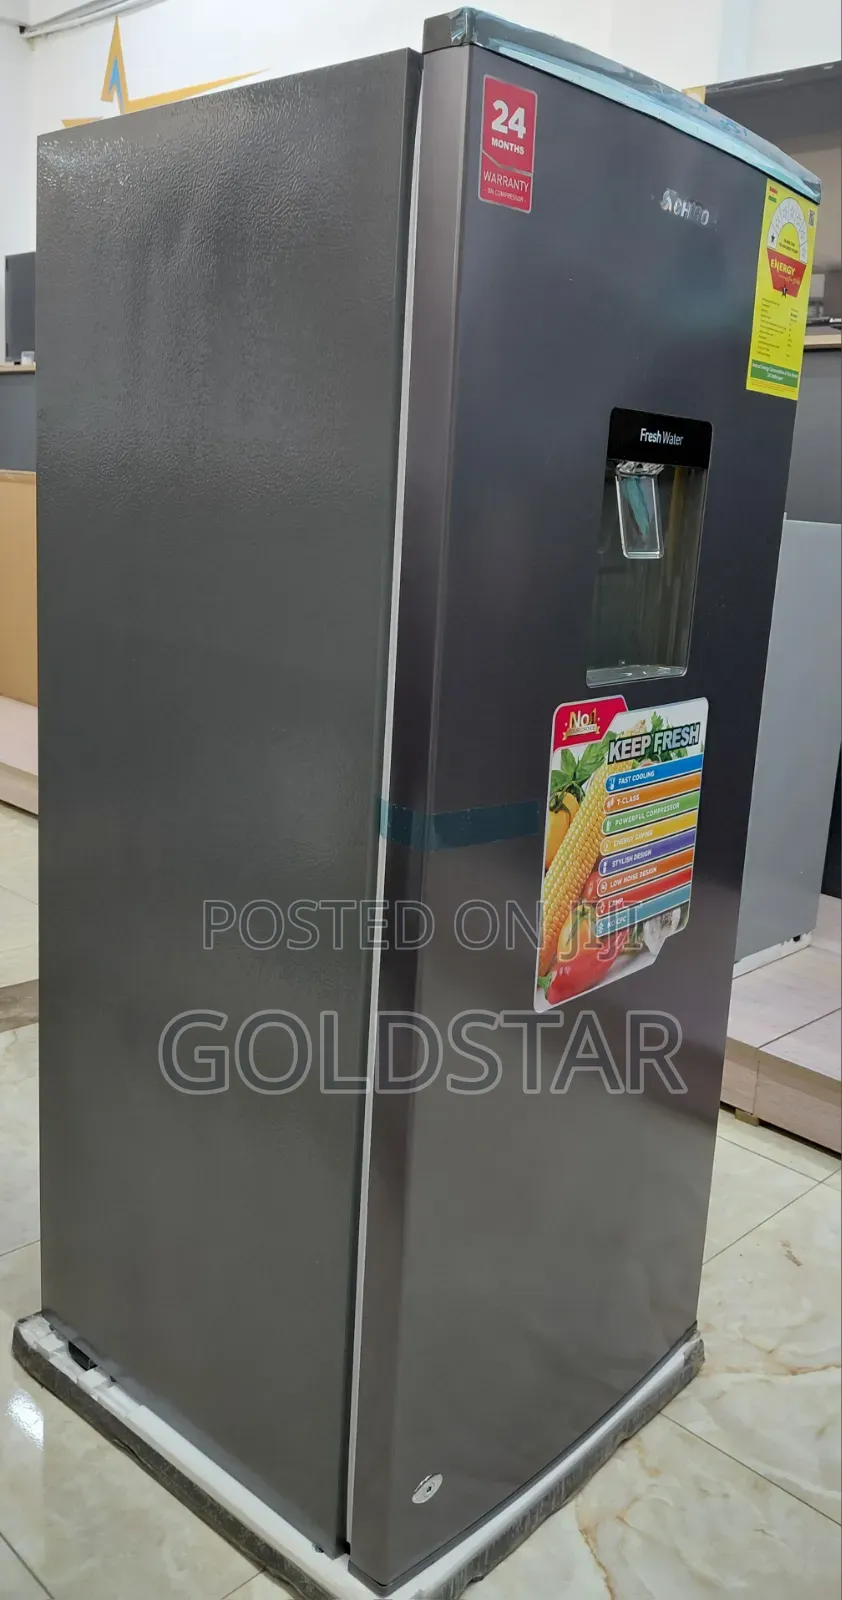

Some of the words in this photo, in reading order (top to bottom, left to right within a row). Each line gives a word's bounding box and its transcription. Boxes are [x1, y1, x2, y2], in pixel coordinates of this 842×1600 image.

[491, 99, 526, 139] 24
[491, 136, 525, 155] MONTHS
[483, 171, 530, 193] WARRANTY
[494, 189, 524, 203] COMPRESSOR
[770, 258, 796, 276] ENERGY
[639, 427, 662, 444] Fresh
[662, 430, 684, 446] Water
[607, 733, 653, 765] KEEP
[653, 722, 701, 754] FRESH
[618, 776, 631, 785] FAST
[631, 770, 655, 782] COOLING
[617, 794, 640, 806] T-CLASS
[615, 812, 645, 826] POWERFUL
[645, 802, 680, 818] COMPRESSOR
[613, 836, 634, 847] ENERGY
[611, 856, 634, 867] STYLISH
[633, 849, 653, 861] DESIGN
[610, 878, 623, 888] LOW
[623, 873, 639, 883] NOISE
[639, 867, 658, 878] DESIGN
